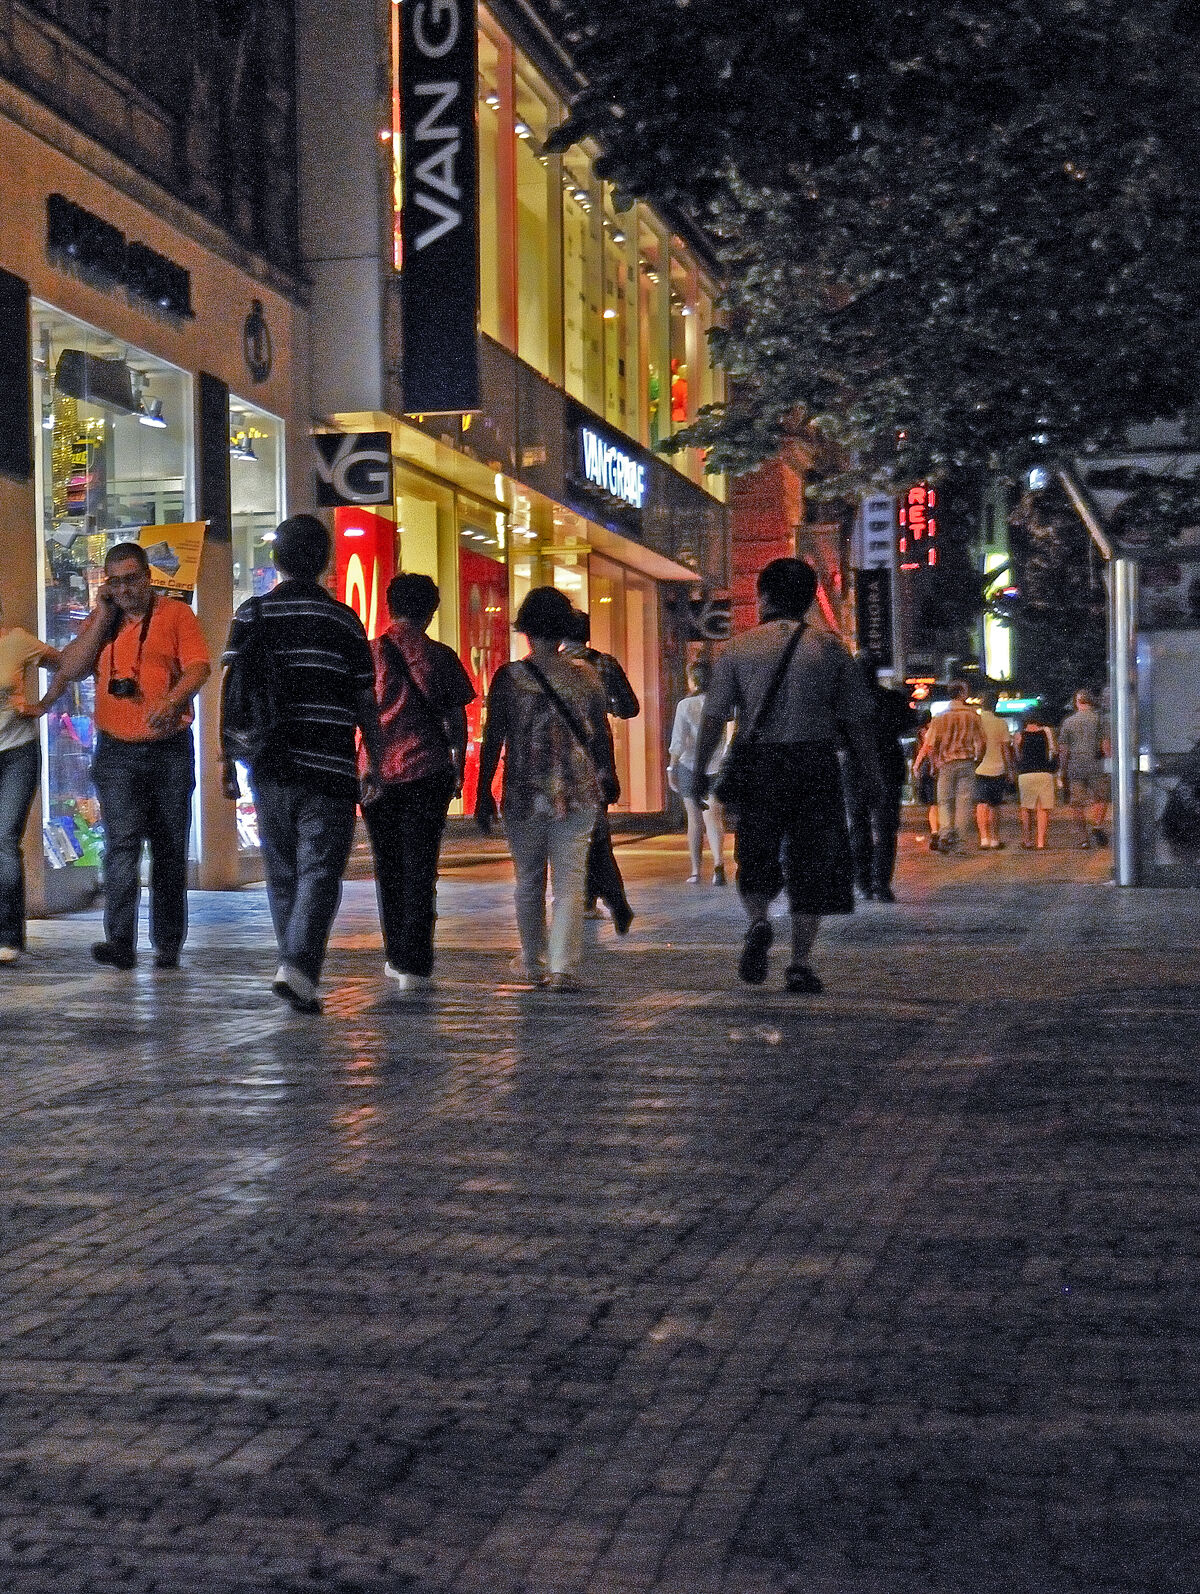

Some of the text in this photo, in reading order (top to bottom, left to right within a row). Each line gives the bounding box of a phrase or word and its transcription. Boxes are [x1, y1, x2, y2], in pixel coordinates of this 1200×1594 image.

[413, 82, 460, 250] VAN
[311, 434, 389, 503] VG
[908, 486, 927, 540] RET
